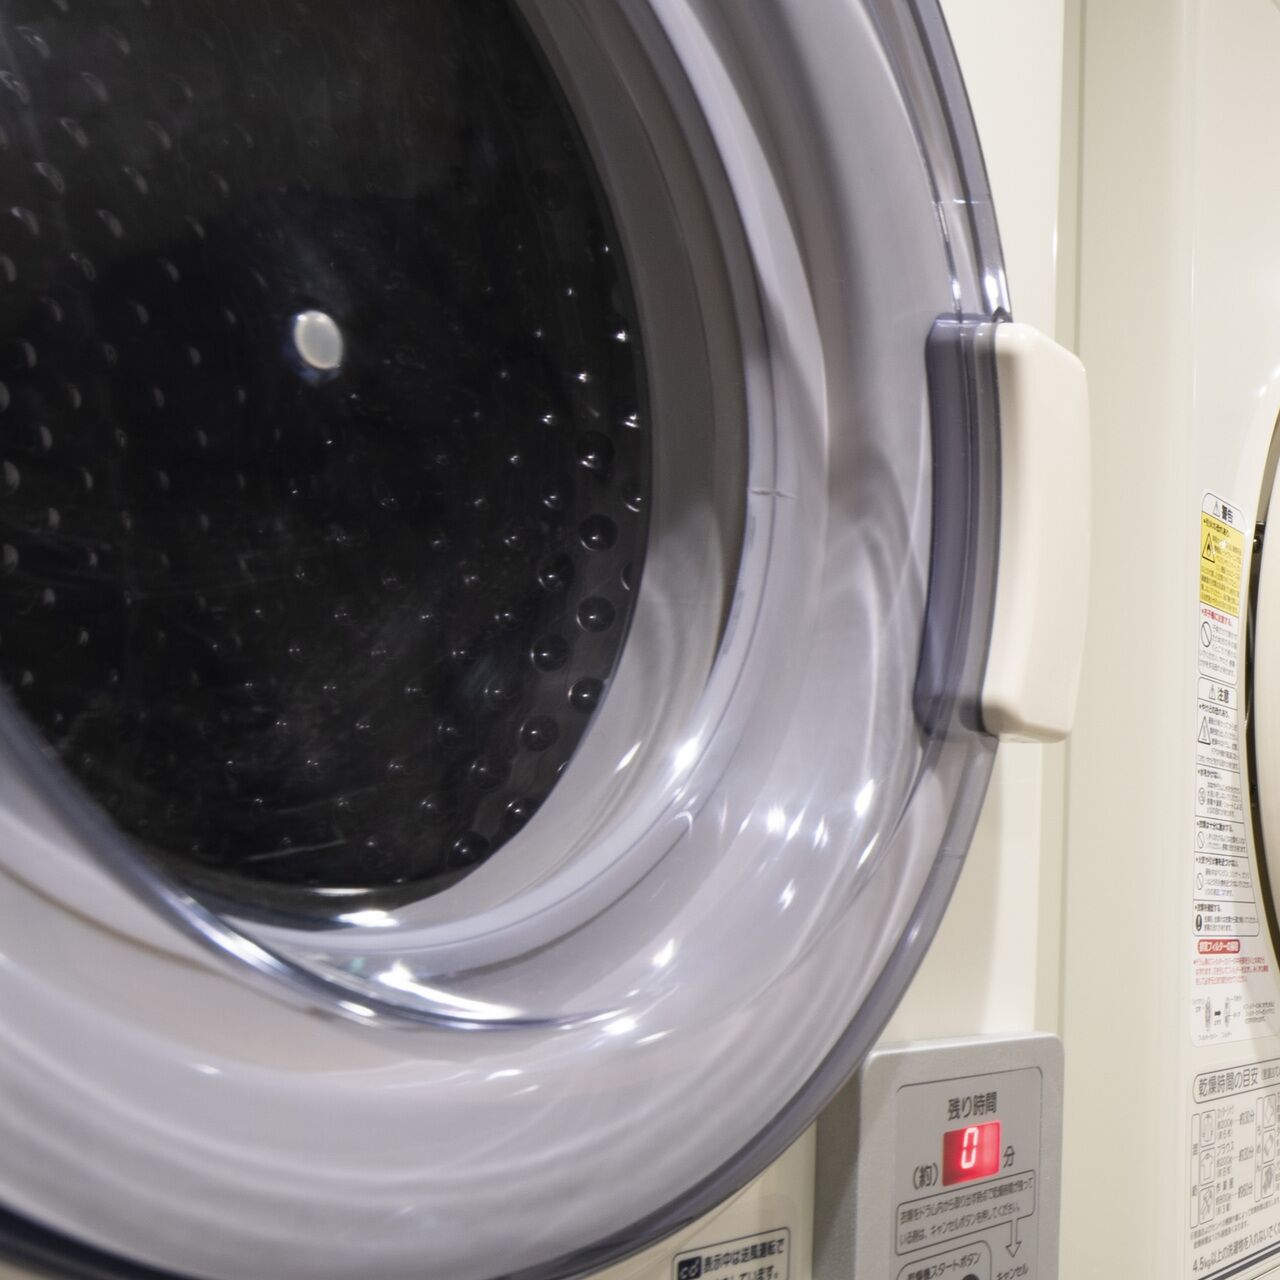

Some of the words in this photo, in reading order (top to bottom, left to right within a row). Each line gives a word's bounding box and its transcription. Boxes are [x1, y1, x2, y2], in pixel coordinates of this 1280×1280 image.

[948, 1091, 999, 1121] 残り時間
[961, 1126, 980, 1170] 0
[1003, 1145, 1015, 1168] 分
